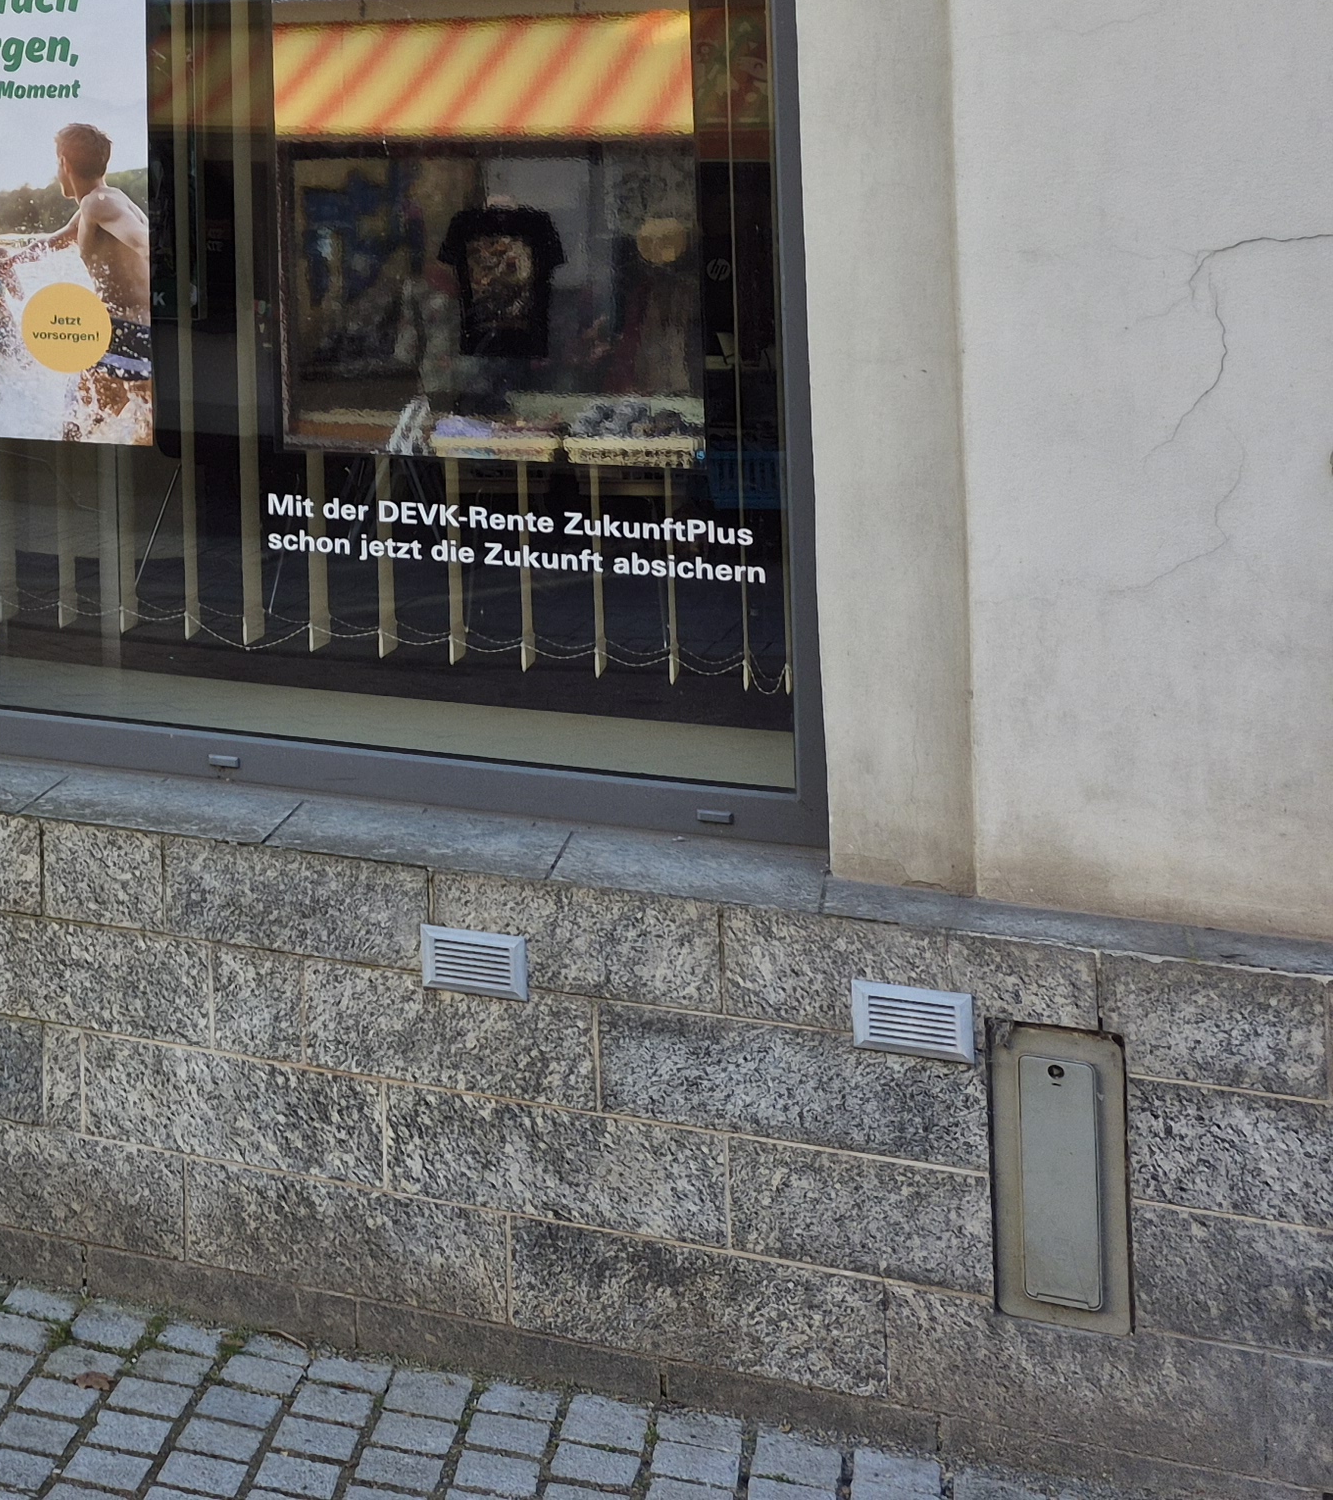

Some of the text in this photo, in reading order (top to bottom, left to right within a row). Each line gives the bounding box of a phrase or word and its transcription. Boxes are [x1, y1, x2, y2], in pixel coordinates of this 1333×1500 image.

[32, 330, 100, 343] vorsorgen!
[50, 314, 81, 327] Jetzt
[267, 493, 754, 546] Mit der DEVK-Rente ZukunftPlus
[267, 529, 767, 584] schon jetzt die Zukunft absichern
